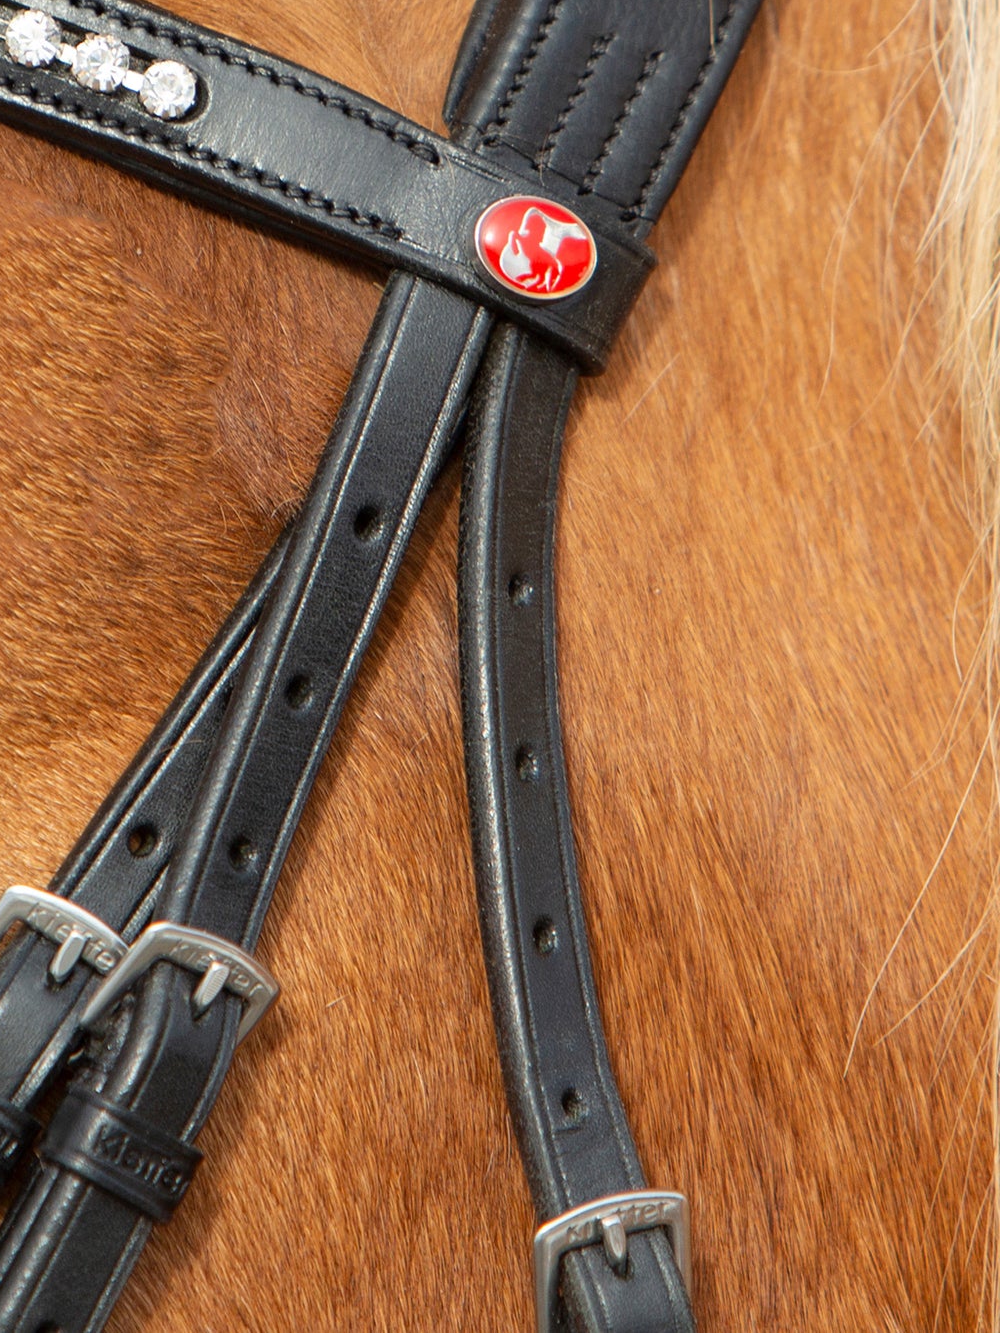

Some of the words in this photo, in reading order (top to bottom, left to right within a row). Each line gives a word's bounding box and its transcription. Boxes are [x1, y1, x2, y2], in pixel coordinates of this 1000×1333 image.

[27, 902, 126, 972] kiefe
[169, 938, 263, 996] kiefer
[566, 1202, 670, 1244] kiffer
